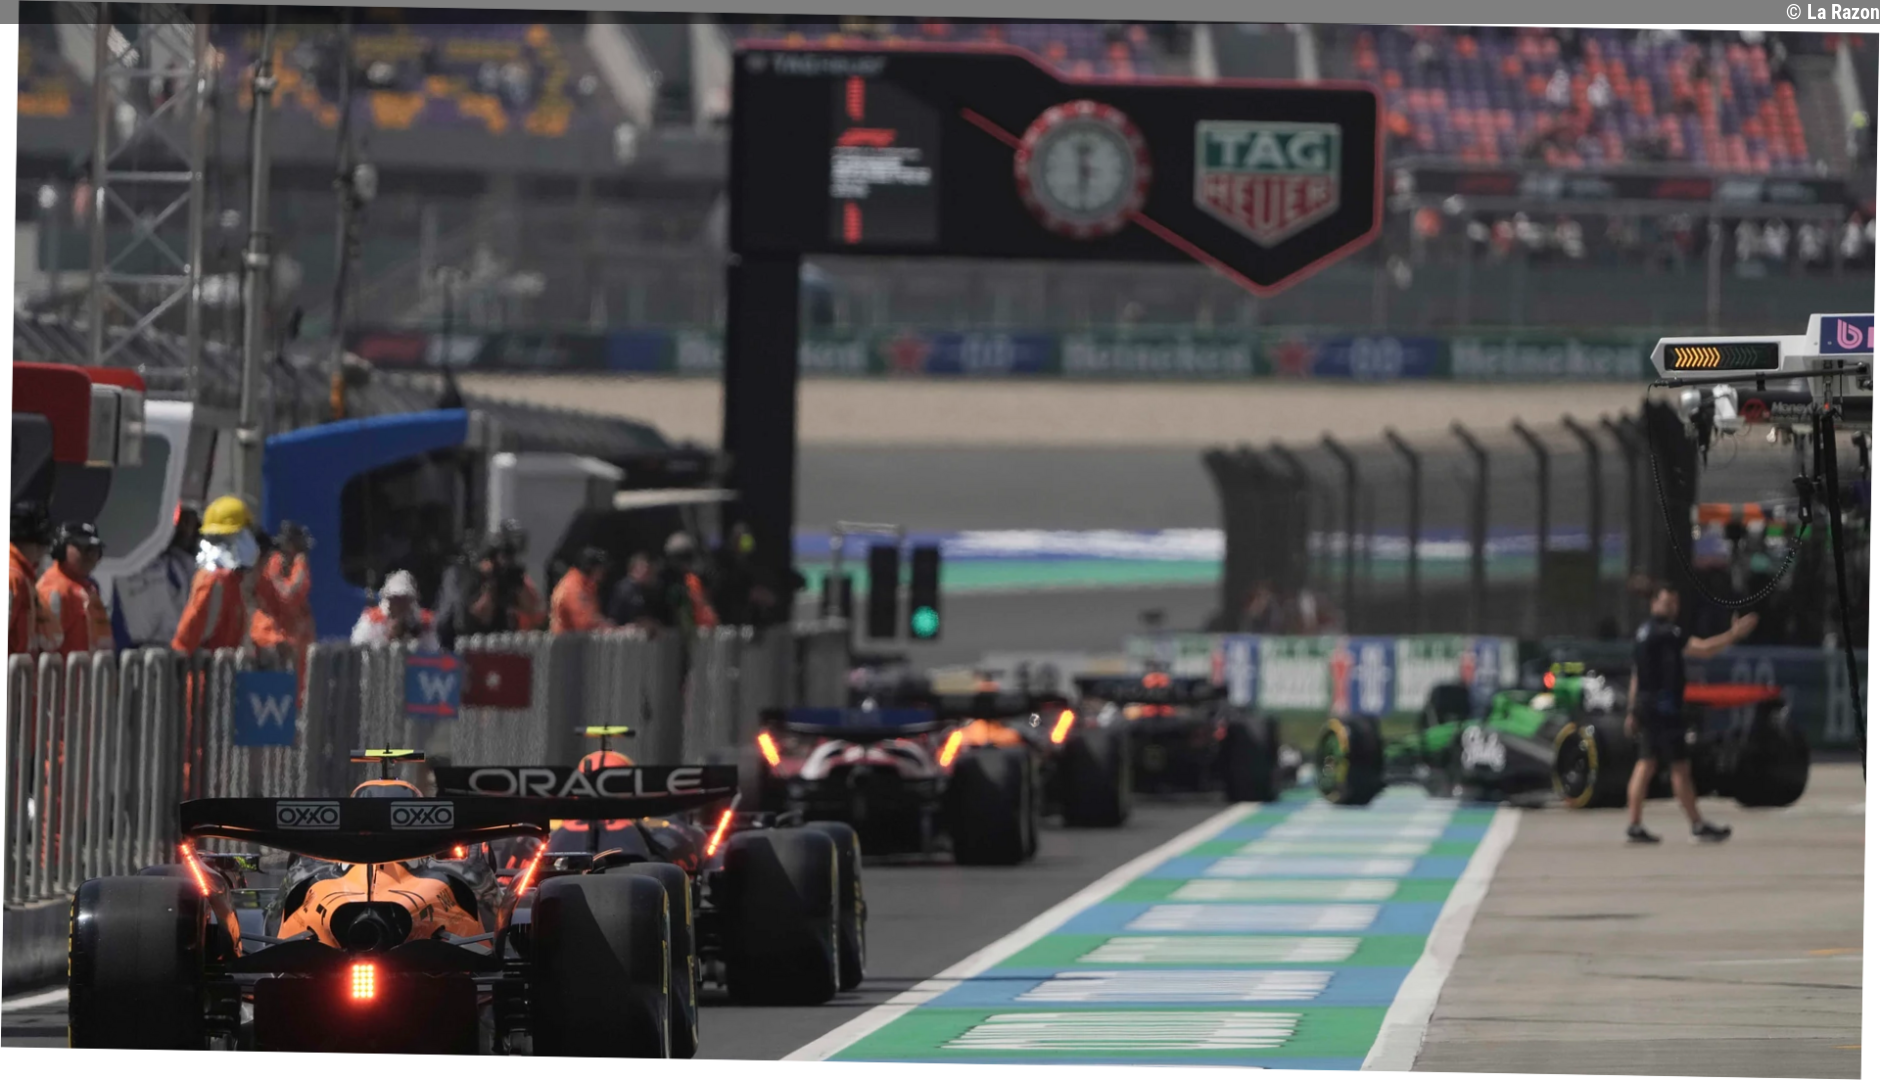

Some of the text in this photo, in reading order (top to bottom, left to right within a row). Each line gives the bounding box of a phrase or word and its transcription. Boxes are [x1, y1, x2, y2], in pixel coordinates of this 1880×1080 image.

[1209, 131, 1326, 169] TAG
[1203, 175, 1331, 238] HEUER
[418, 670, 457, 703] W
[249, 692, 294, 729] W
[469, 768, 704, 798] ORACLE
[277, 804, 453, 827] OXXO OXXO
